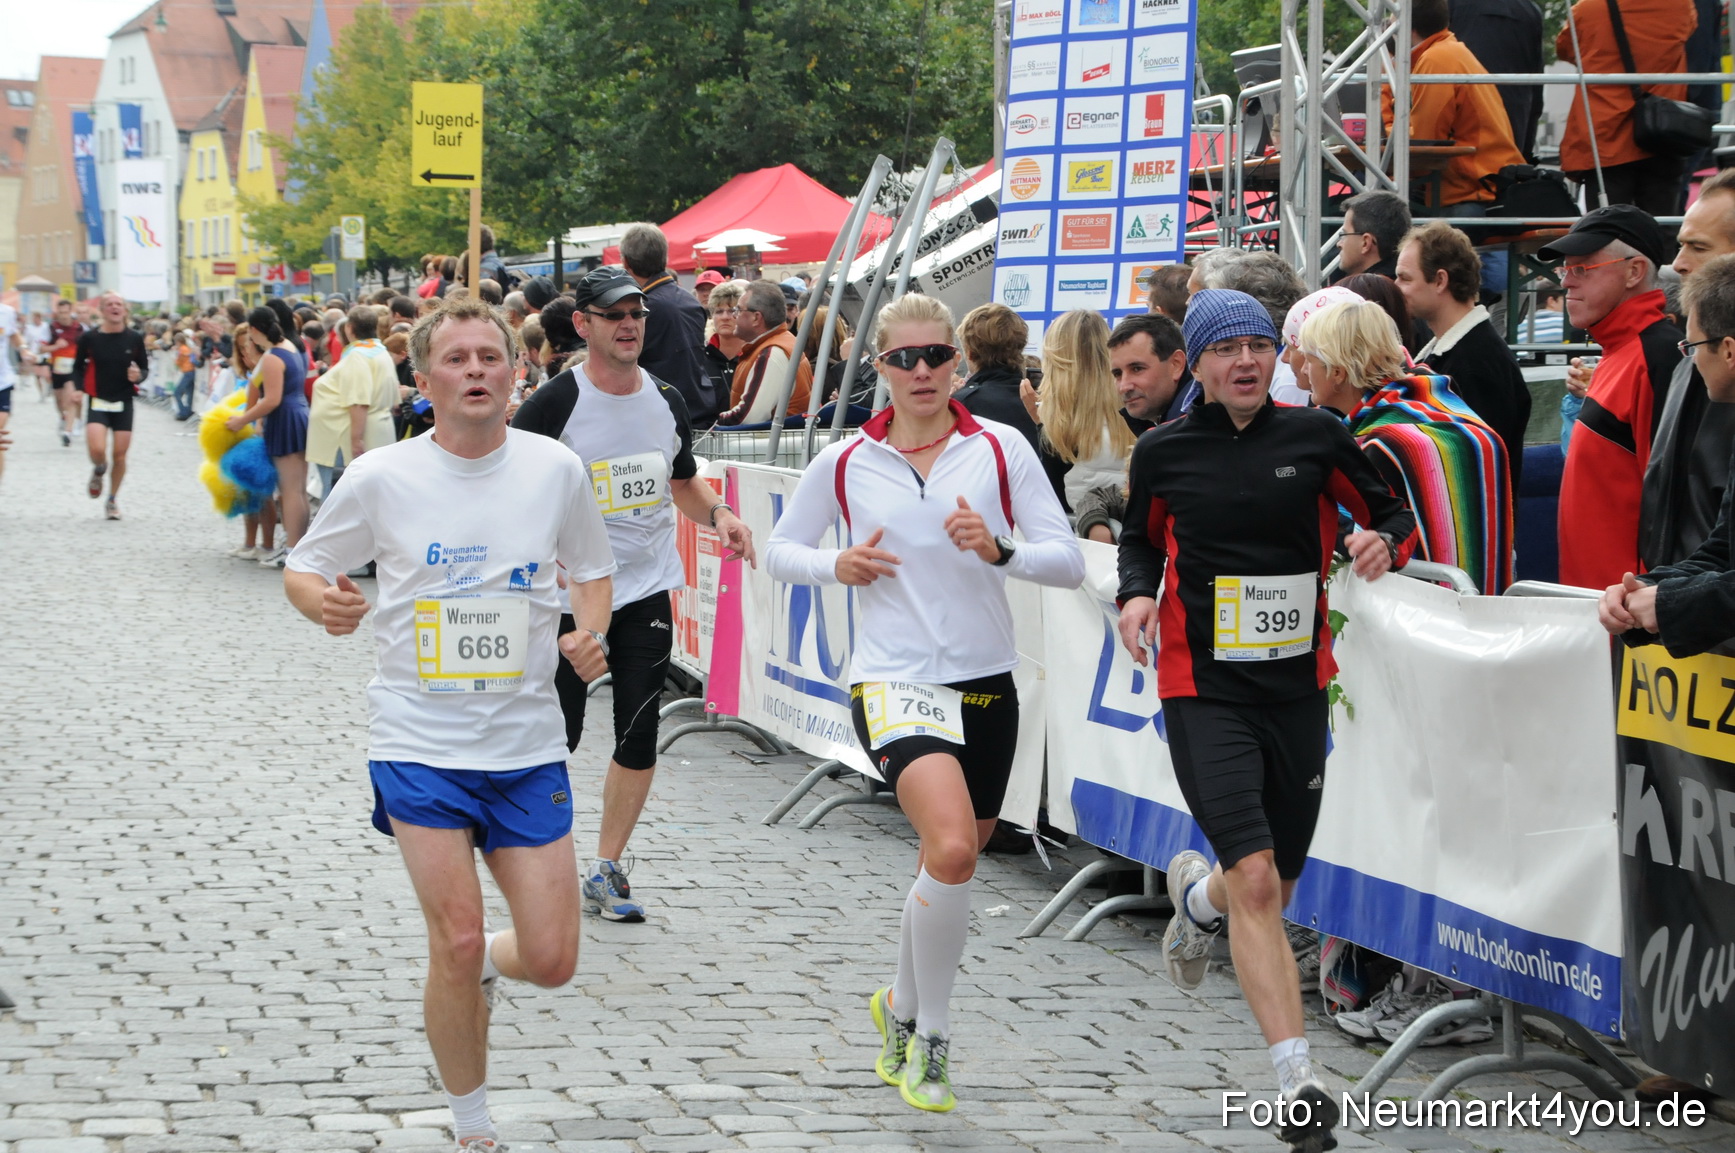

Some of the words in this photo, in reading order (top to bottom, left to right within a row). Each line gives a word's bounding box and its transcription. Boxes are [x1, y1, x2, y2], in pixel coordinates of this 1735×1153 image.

[1144, 57, 1179, 67] BIONORICA
[416, 110, 479, 130] Jugend-
[1082, 111, 1120, 123] Egner
[433, 131, 463, 147] lauf
[1133, 160, 1175, 176] MERZ
[1130, 173, 1164, 185] Reisen
[1001, 228, 1028, 240] swn
[612, 462, 643, 477] Stefan
[597, 486, 602, 495] B
[622, 478, 656, 499] 832
[426, 542, 448, 565] 6.
[443, 545, 488, 555] Neumarkter
[453, 553, 487, 563] Stadtlauf
[1245, 585, 1287, 600] Mauro
[446, 607, 501, 624] Werner
[1220, 609, 1226, 621] C
[1255, 608, 1300, 633] 399
[422, 634, 429, 647] B
[458, 635, 509, 659] 668
[889, 682, 934, 699] Verena
[900, 698, 946, 722] 766
[1437, 921, 1602, 1001] www.bockonline.de
